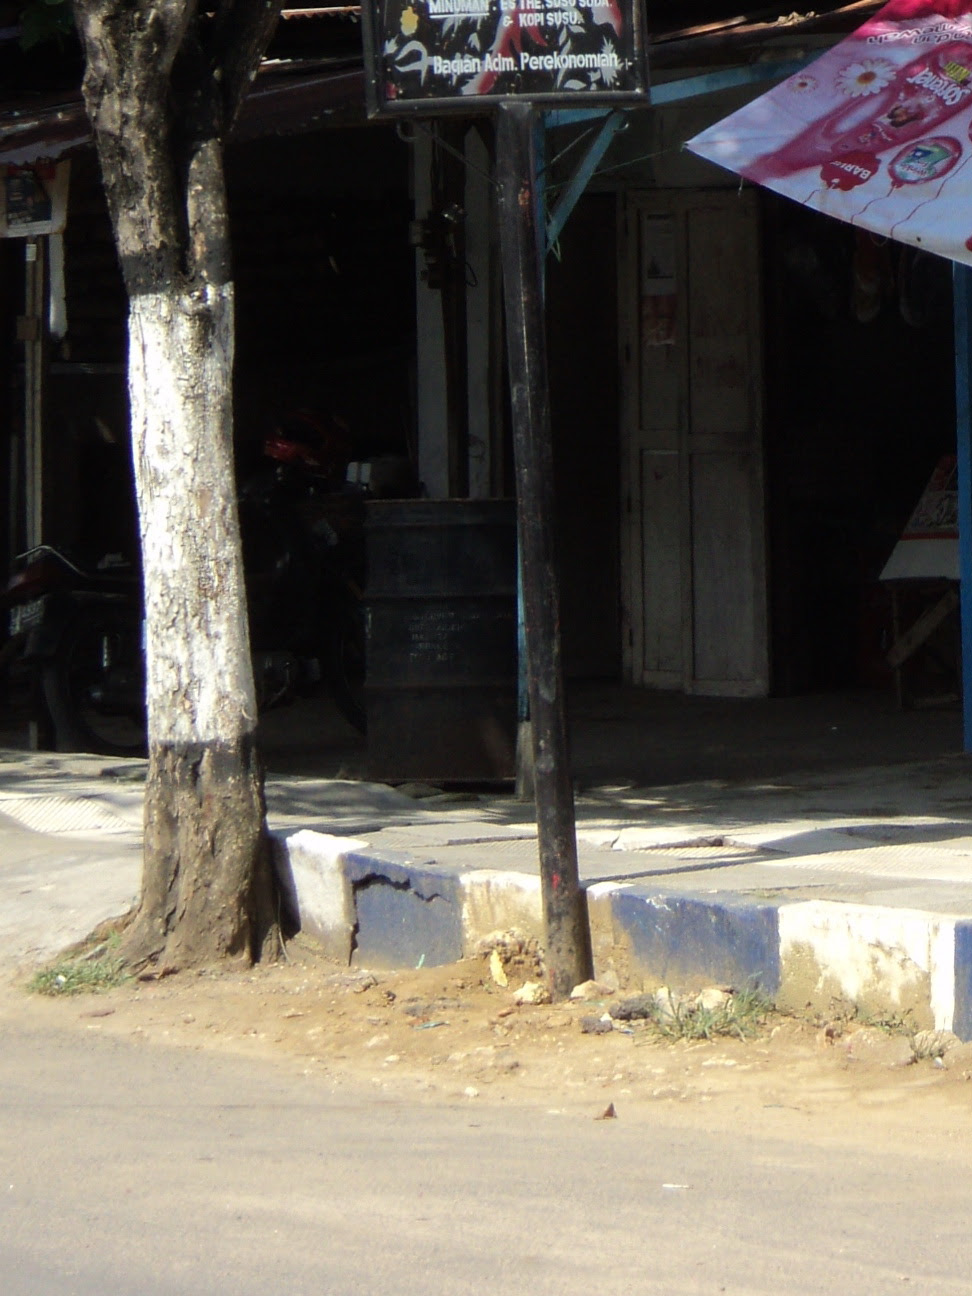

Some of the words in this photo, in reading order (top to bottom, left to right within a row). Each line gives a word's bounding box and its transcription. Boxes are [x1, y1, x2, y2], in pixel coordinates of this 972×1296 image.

[503, 15, 513, 27] &
[519, 13, 544, 27] KOPI
[434, 55, 482, 75] Bagian
[484, 52, 518, 72] Adm.
[520, 51, 619, 71] Perekonomian
